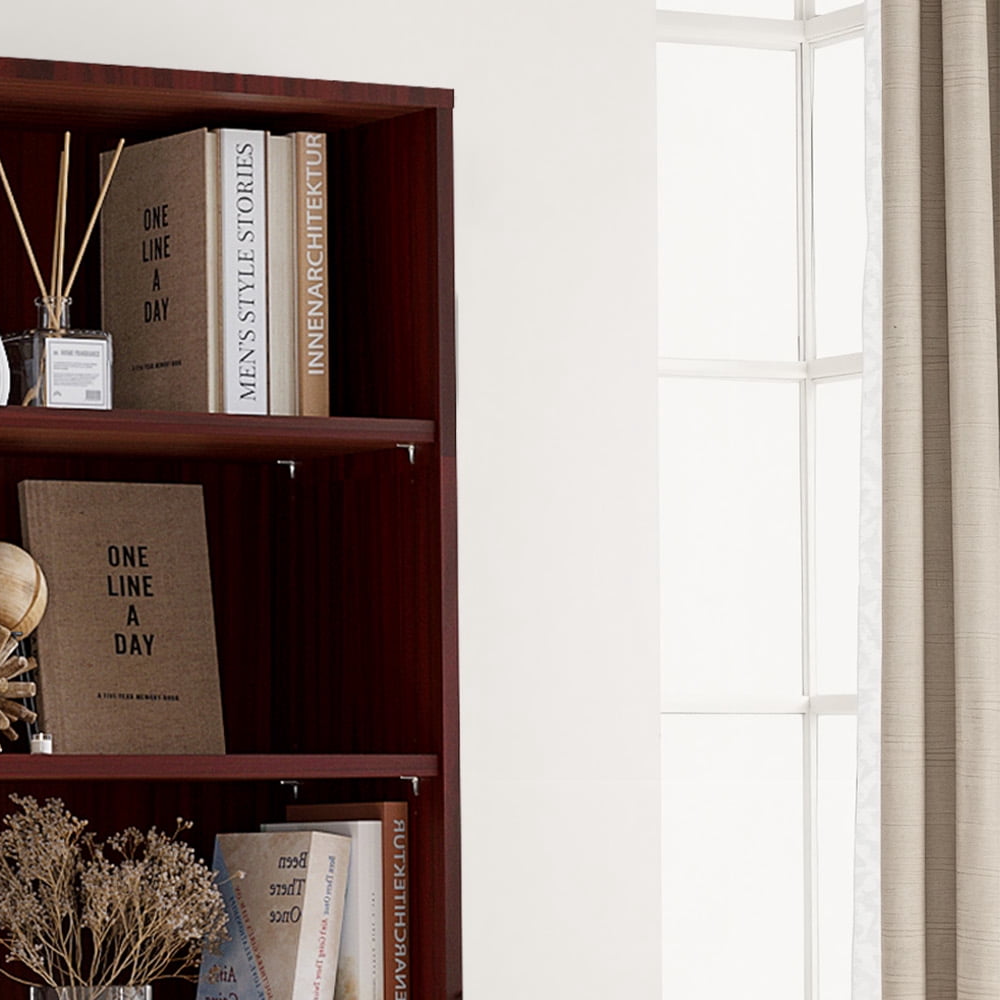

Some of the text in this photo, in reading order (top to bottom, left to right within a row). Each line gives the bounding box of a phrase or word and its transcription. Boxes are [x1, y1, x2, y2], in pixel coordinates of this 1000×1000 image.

[143, 204, 169, 231] ONE
[142, 235, 171, 263] LINE
[306, 133, 325, 375] INNENARCHITEKTUR
[152, 268, 161, 292] A
[236, 143, 257, 402] MEN'S STYLE STORIES
[144, 298, 169, 323] DAY
[107, 545, 149, 568] ONE
[107, 575, 154, 597] LINE
[126, 604, 140, 627] A
[114, 633, 154, 656] DAY
